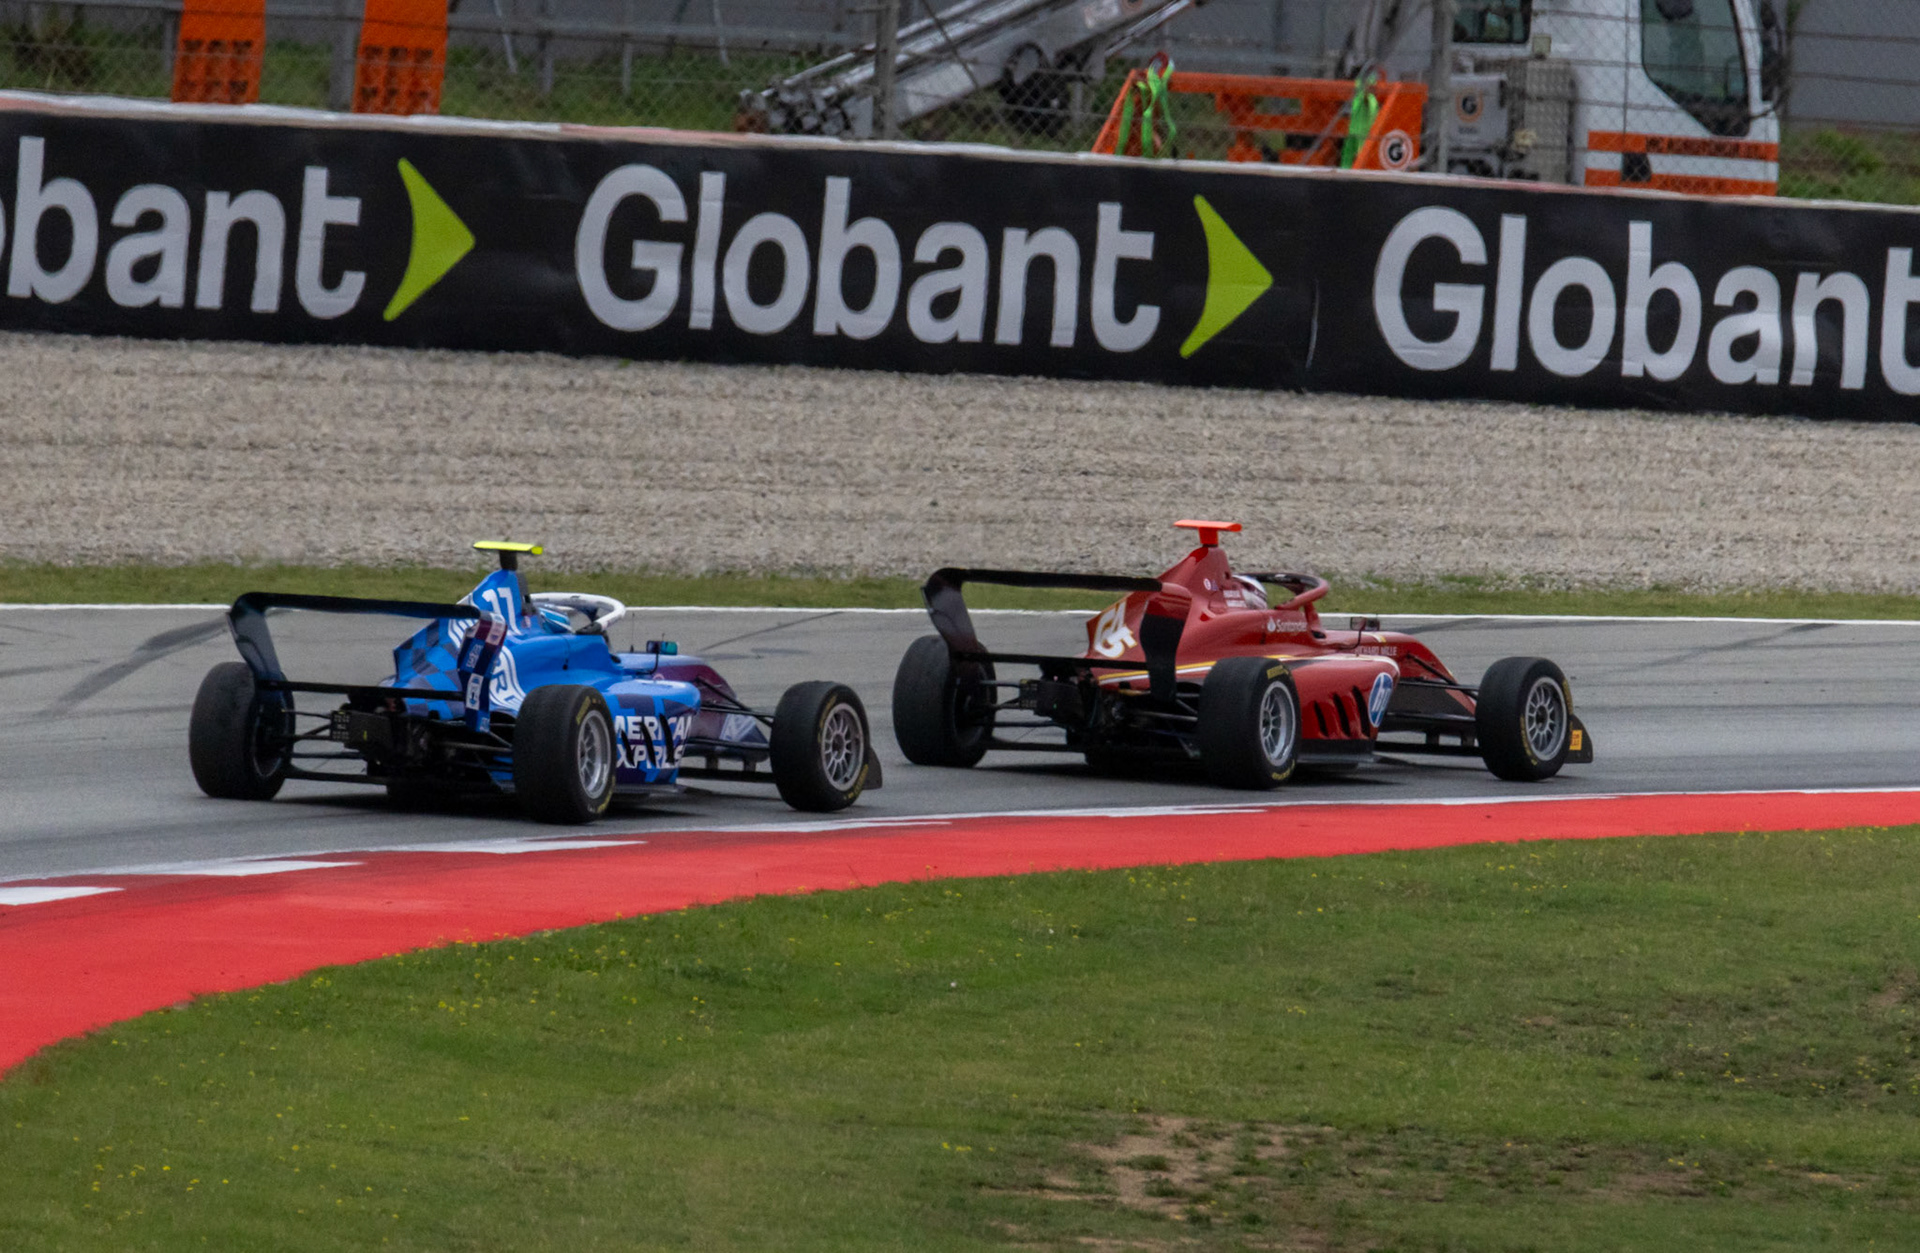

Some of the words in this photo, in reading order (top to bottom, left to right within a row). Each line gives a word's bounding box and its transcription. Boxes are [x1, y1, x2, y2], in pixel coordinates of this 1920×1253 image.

[0, 137, 366, 321] bant
[1388, 142, 1403, 163] G
[577, 165, 1160, 354] Globant
[1375, 208, 1920, 395] Globant
